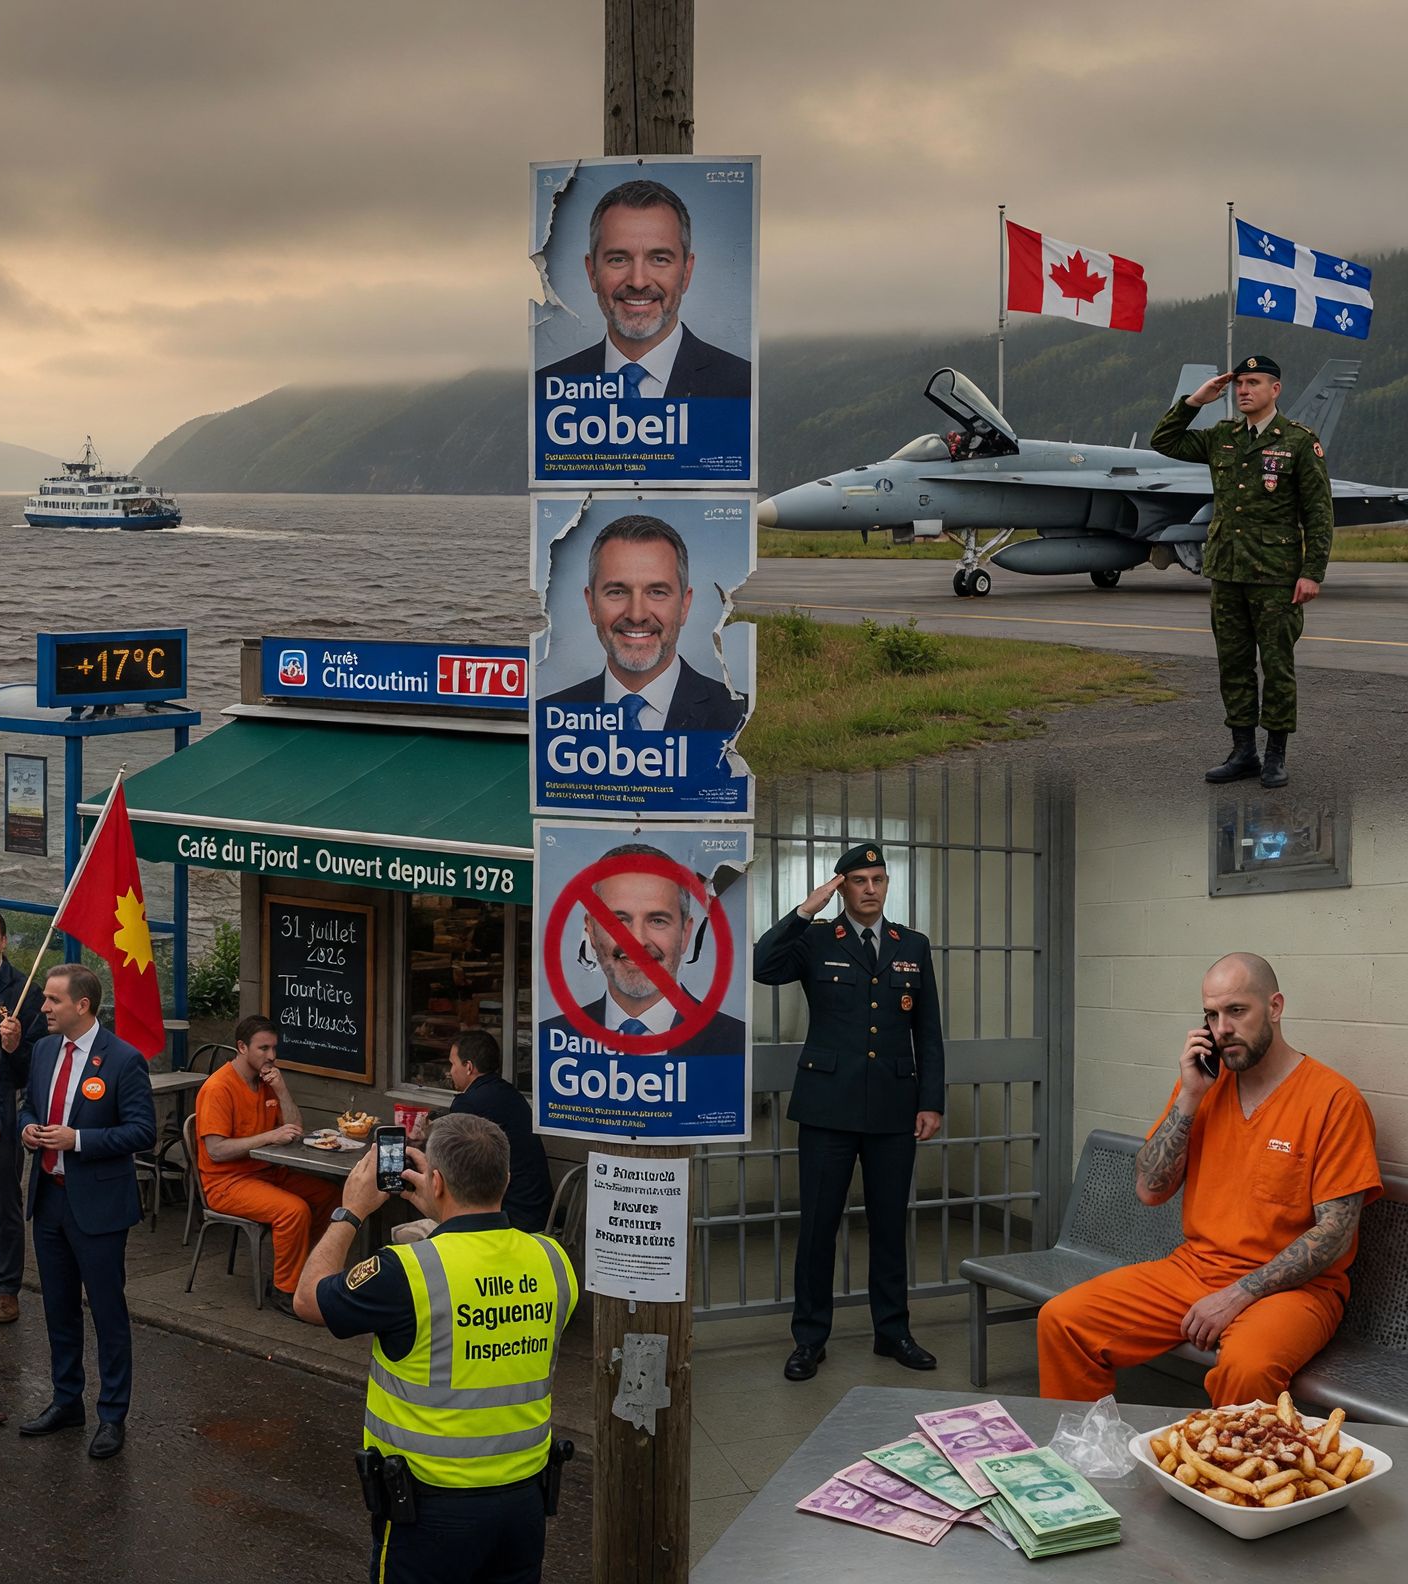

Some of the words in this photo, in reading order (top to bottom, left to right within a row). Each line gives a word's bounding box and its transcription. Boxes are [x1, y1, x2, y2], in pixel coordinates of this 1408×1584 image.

[545, 375, 624, 400] Daniel
[545, 403, 689, 446] Gobeil
[322, 667, 429, 693] Chicoutimi
[546, 706, 624, 731] Daniel
[546, 734, 688, 778] Gobeil
[177, 834, 217, 860] Café
[222, 838, 245, 863] du
[250, 841, 298, 871] Fjord
[315, 848, 383, 879] Ouvert
[388, 857, 456, 889] depuis
[463, 865, 514, 894] 1978
[281, 915, 303, 938] 31
[549, 1057, 687, 1103] Gobeil
[474, 1276, 514, 1298] Ville
[519, 1273, 538, 1294] de
[456, 1301, 554, 1331] Saguenay
[464, 1335, 548, 1362] Inspection
